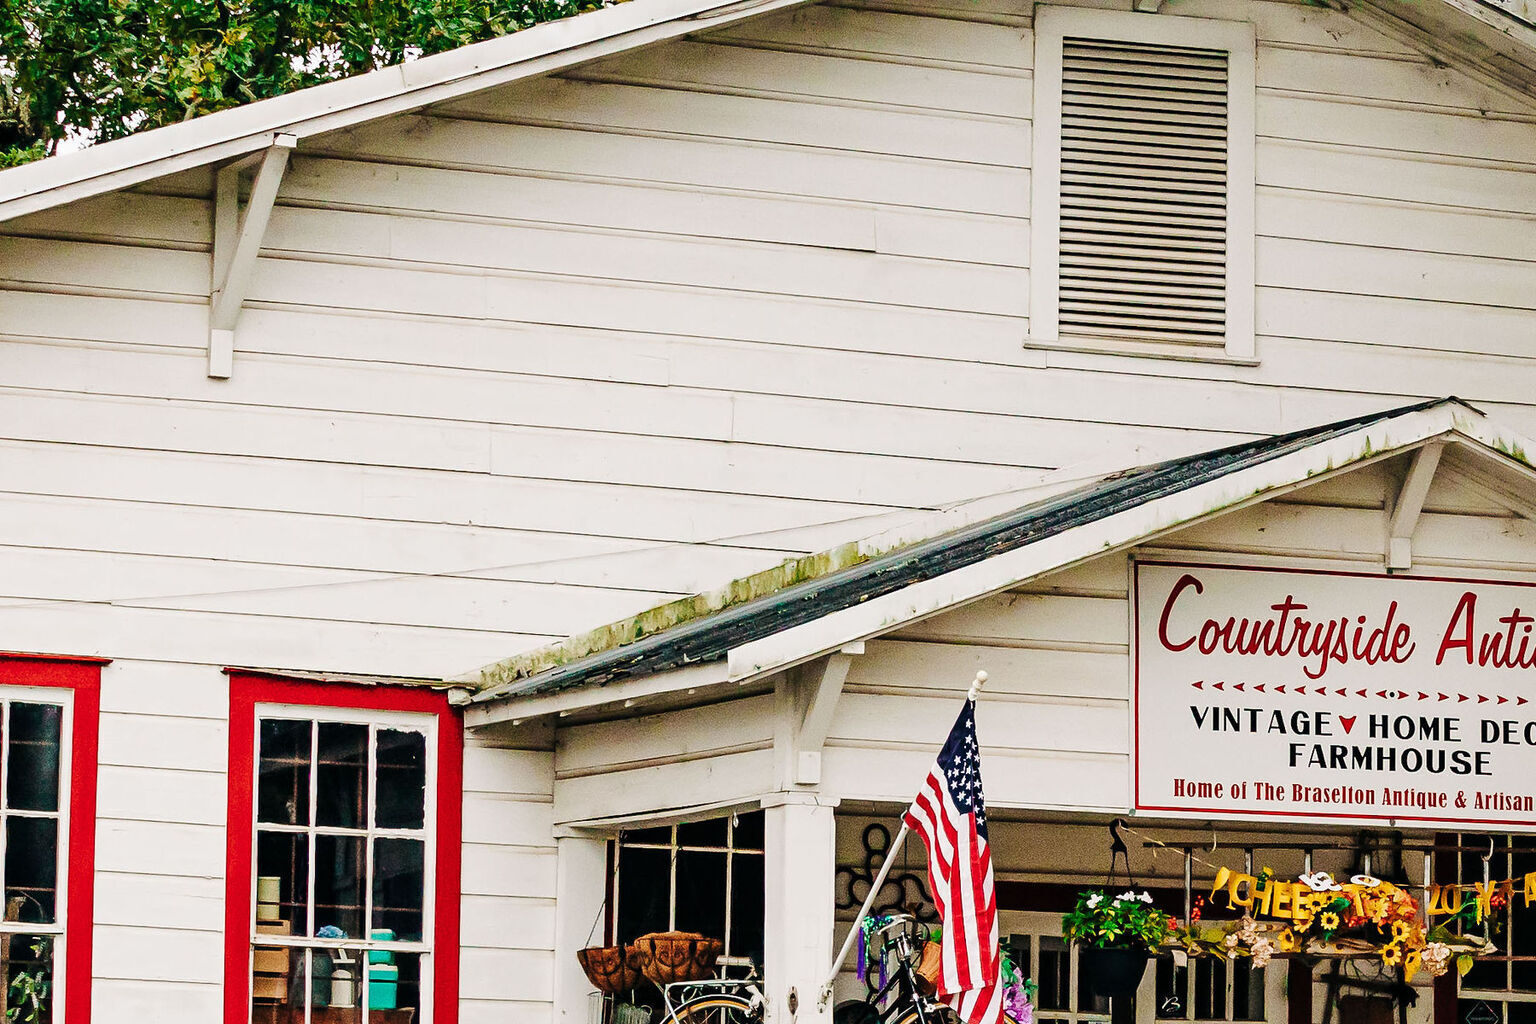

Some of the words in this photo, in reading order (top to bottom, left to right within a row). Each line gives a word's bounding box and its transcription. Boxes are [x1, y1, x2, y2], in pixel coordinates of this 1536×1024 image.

[1159, 574, 1415, 680] Countryside
[1190, 706, 1333, 737] VINTAGE
[1369, 714, 1462, 742] HOME
[1289, 743, 1493, 776] FARMHOUSE
[1173, 778, 1224, 798] Home
[1229, 782, 1249, 800] of
[1254, 782, 1286, 801] The
[1292, 783, 1376, 805] Braselton
[1382, 787, 1448, 809] Antique
[1453, 790, 1467, 809] &
[1474, 791, 1534, 812] Artisan
